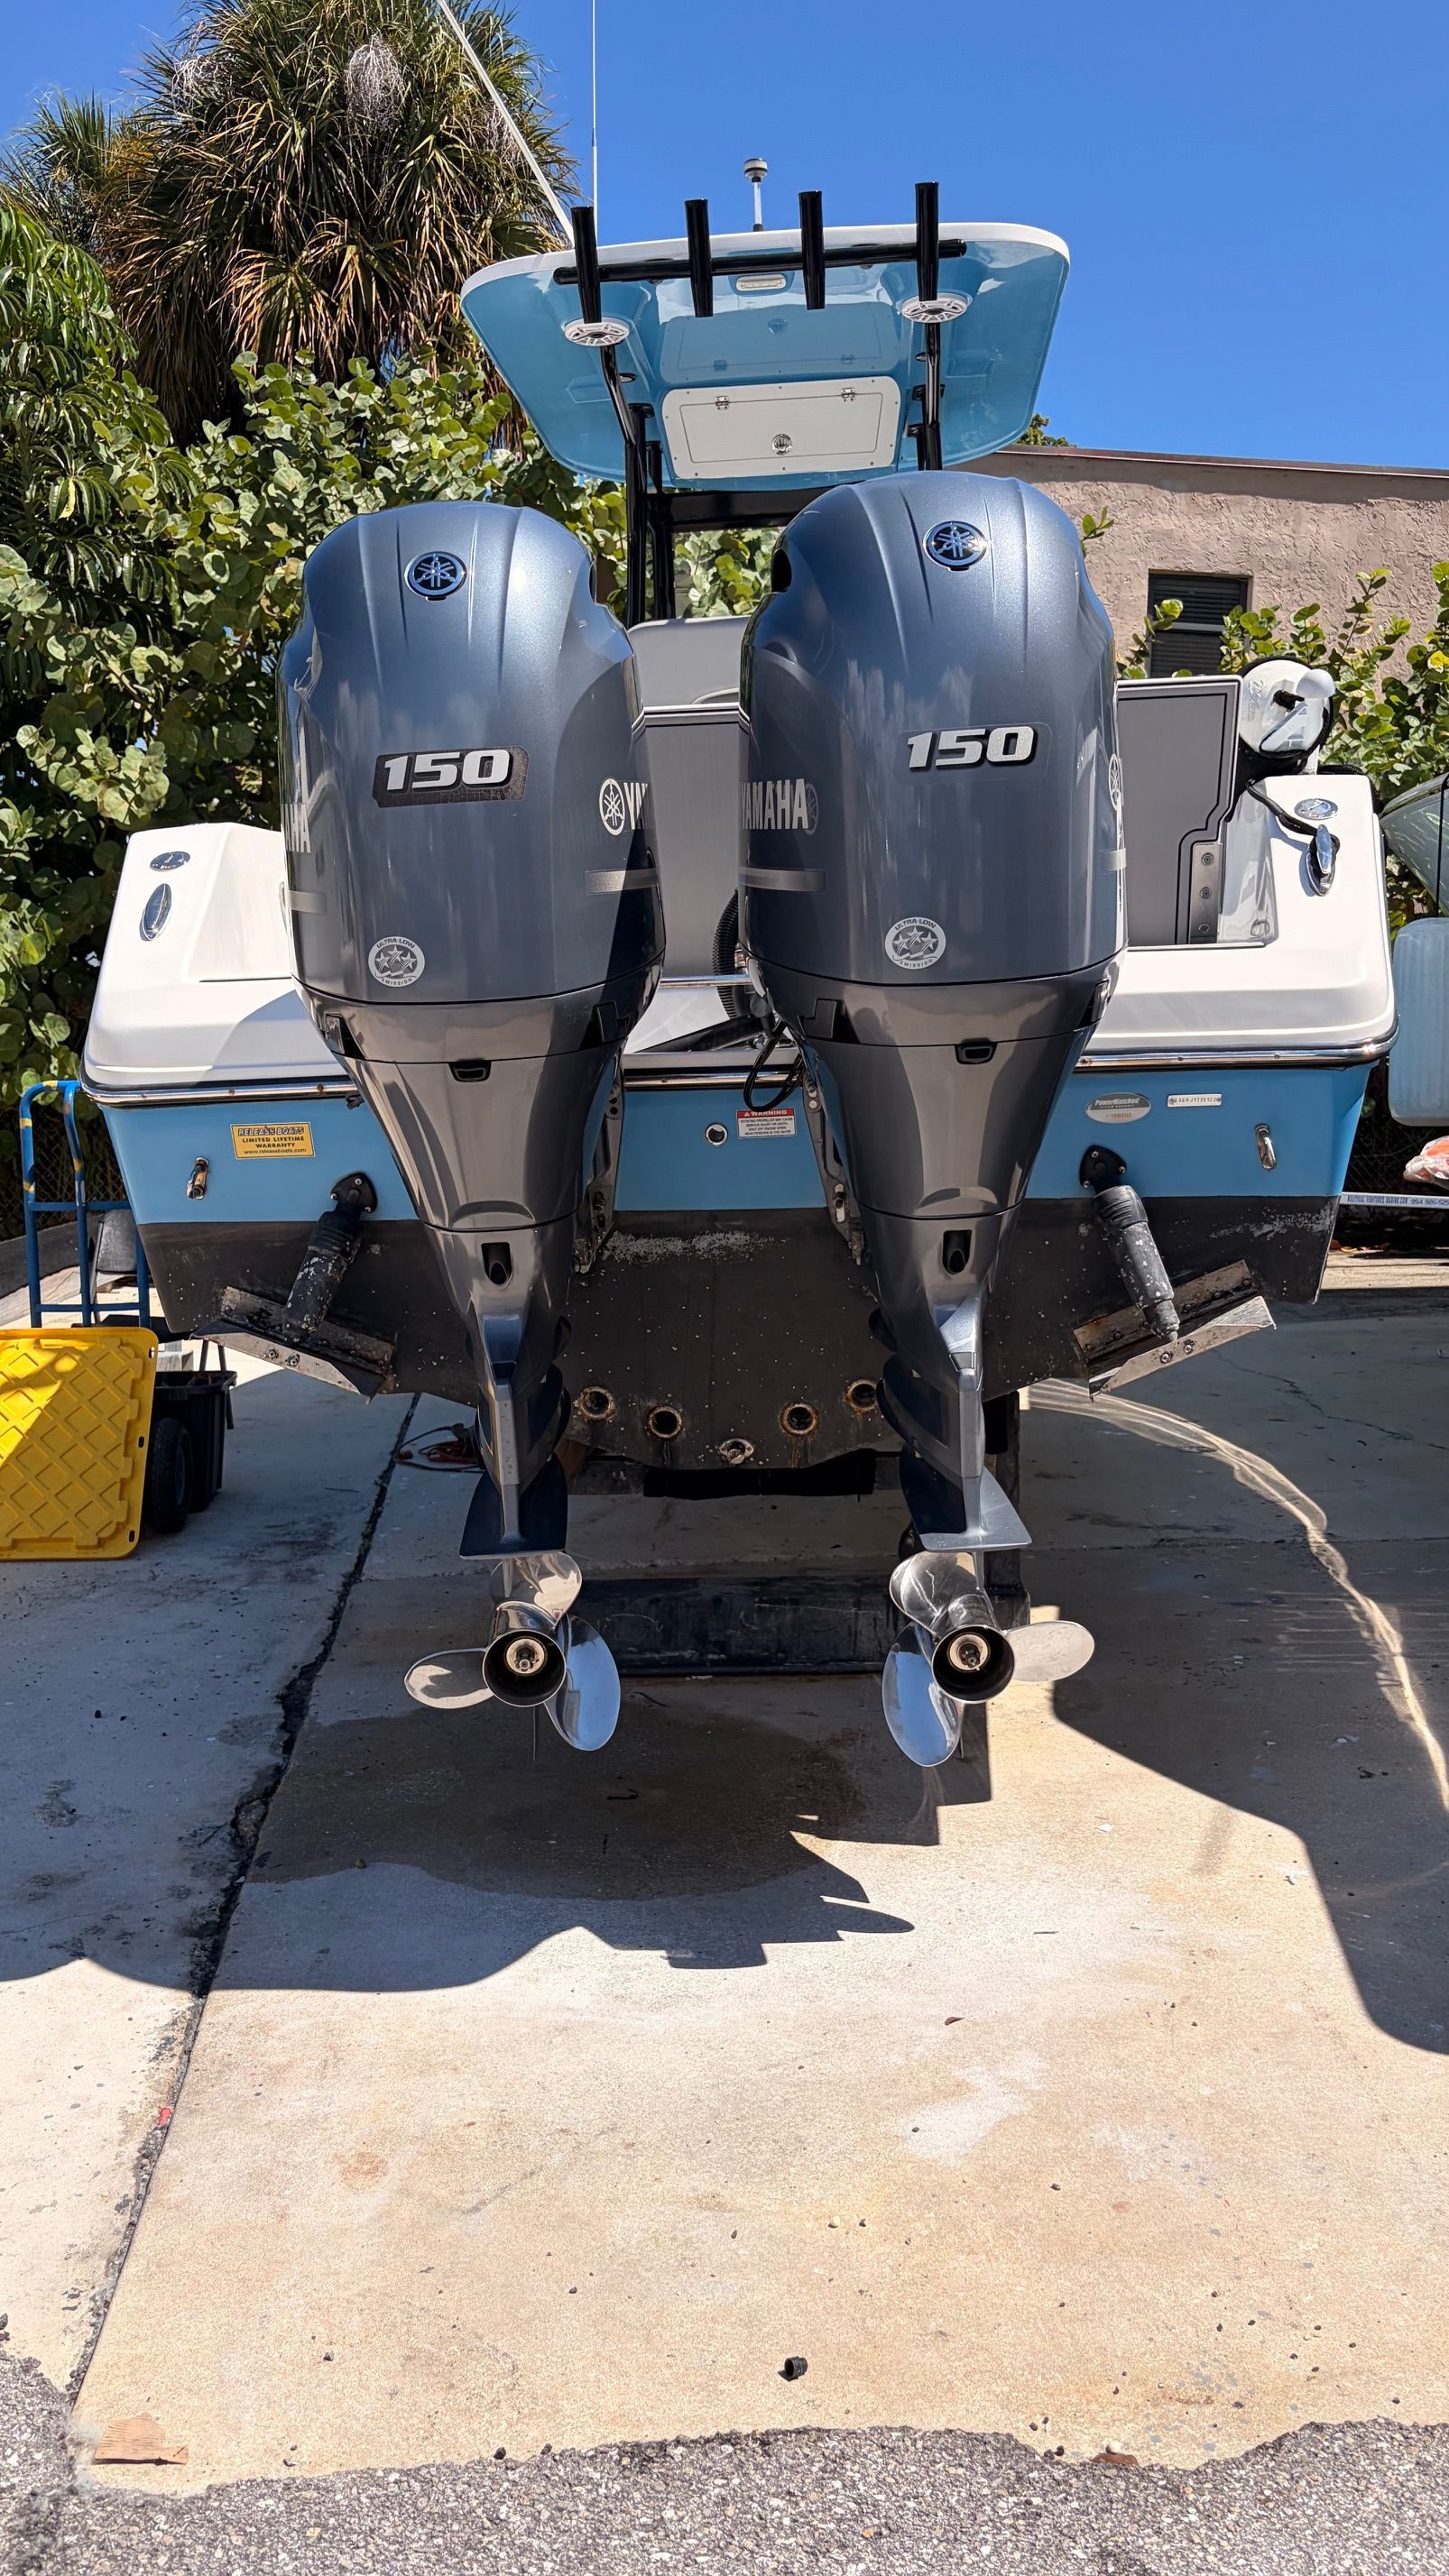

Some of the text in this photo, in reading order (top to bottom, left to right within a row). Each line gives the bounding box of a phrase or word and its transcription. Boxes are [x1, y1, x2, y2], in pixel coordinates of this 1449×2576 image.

[907, 725, 1034, 769] 150
[384, 749, 511, 791] 150
[741, 778, 808, 829] YAMAHA
